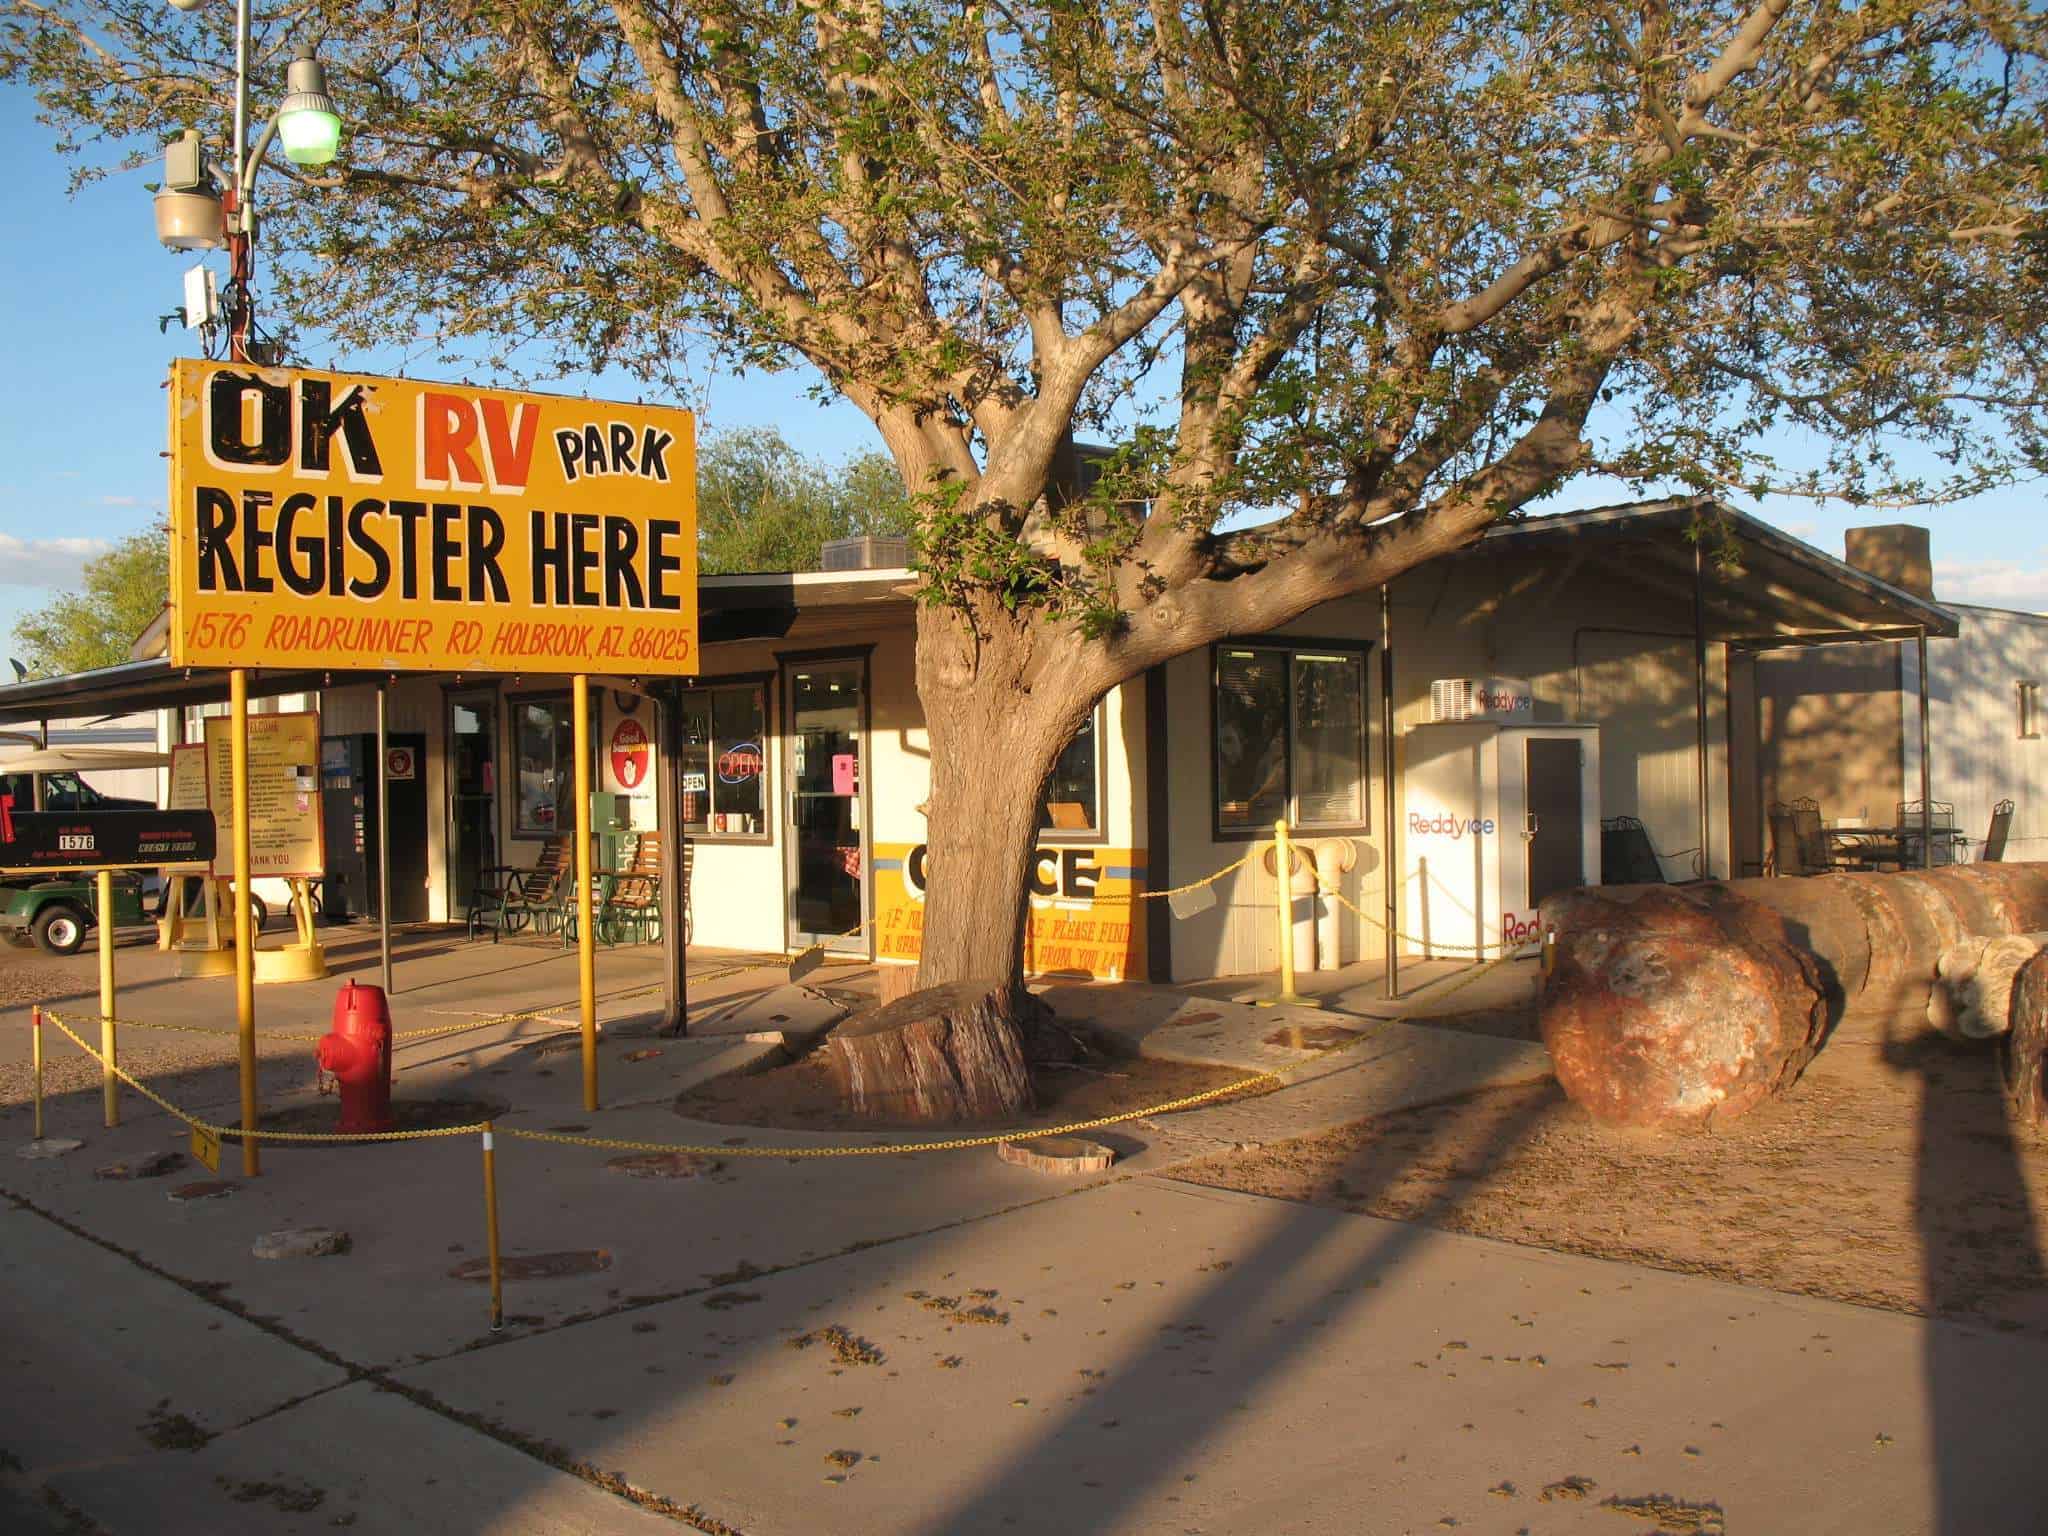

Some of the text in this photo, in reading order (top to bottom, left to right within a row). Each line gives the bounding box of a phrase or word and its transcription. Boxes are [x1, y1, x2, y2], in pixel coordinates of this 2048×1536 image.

[203, 370, 677, 496] OK RV PARK
[194, 485, 683, 613] REGISTER HERE
[188, 612, 253, 650] 1576
[263, 614, 433, 654] ROADRUNNER
[490, 622, 594, 661] HOLBROOK,
[628, 628, 691, 660] 86025
[718, 752, 761, 776] OPEN
[61, 836, 94, 849] 1576
[272, 854, 289, 865] YOU
[1051, 919, 1096, 942] PLEASE
[1503, 911, 1541, 944] Red
[1078, 948, 1099, 970] YOU
